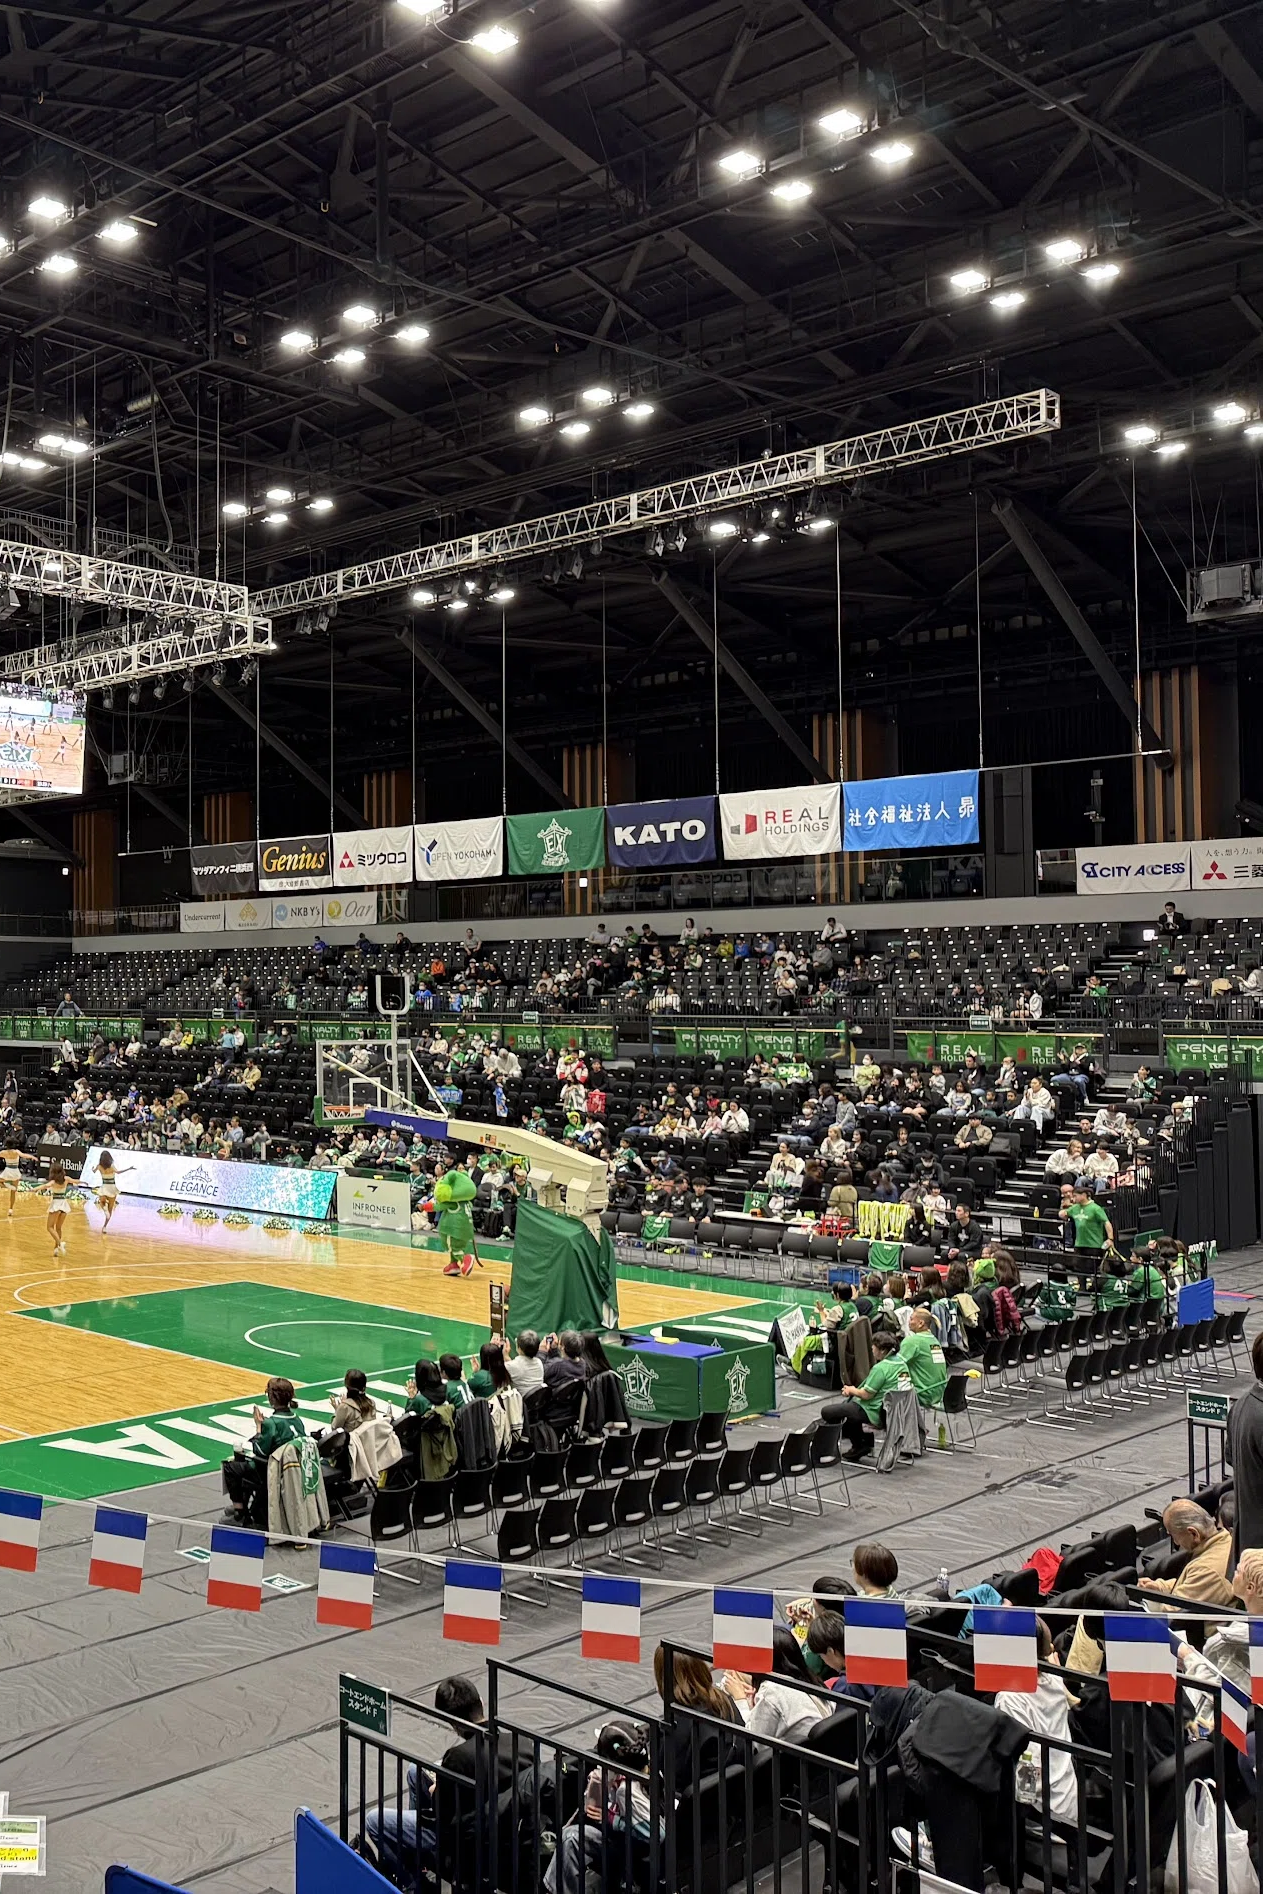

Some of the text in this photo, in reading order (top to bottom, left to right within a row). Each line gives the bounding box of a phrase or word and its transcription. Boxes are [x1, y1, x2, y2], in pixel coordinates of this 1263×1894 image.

[764, 806, 830, 825] REAL
[614, 819, 706, 846] KATO
[764, 821, 830, 836] HOLDINGS
[545, 833, 564, 852] EX
[262, 845, 327, 873] Genius
[357, 851, 407, 867] ミツウロコ
[454, 849, 497, 860] YOKOHAMA
[1099, 862, 1185, 878] CITY ACCESS
[290, 907, 308, 917] NKB
[344, 901, 374, 917] Oar
[169, 1181, 219, 1197] ELEGANCE
[352, 1202, 396, 1215] INFRONEER
[627, 1370, 651, 1394] EX
[731, 1372, 745, 1394] EX
[339, 1685, 387, 1711] コートエンドホーム
[348, 1698, 378, 1717] スタンド F
